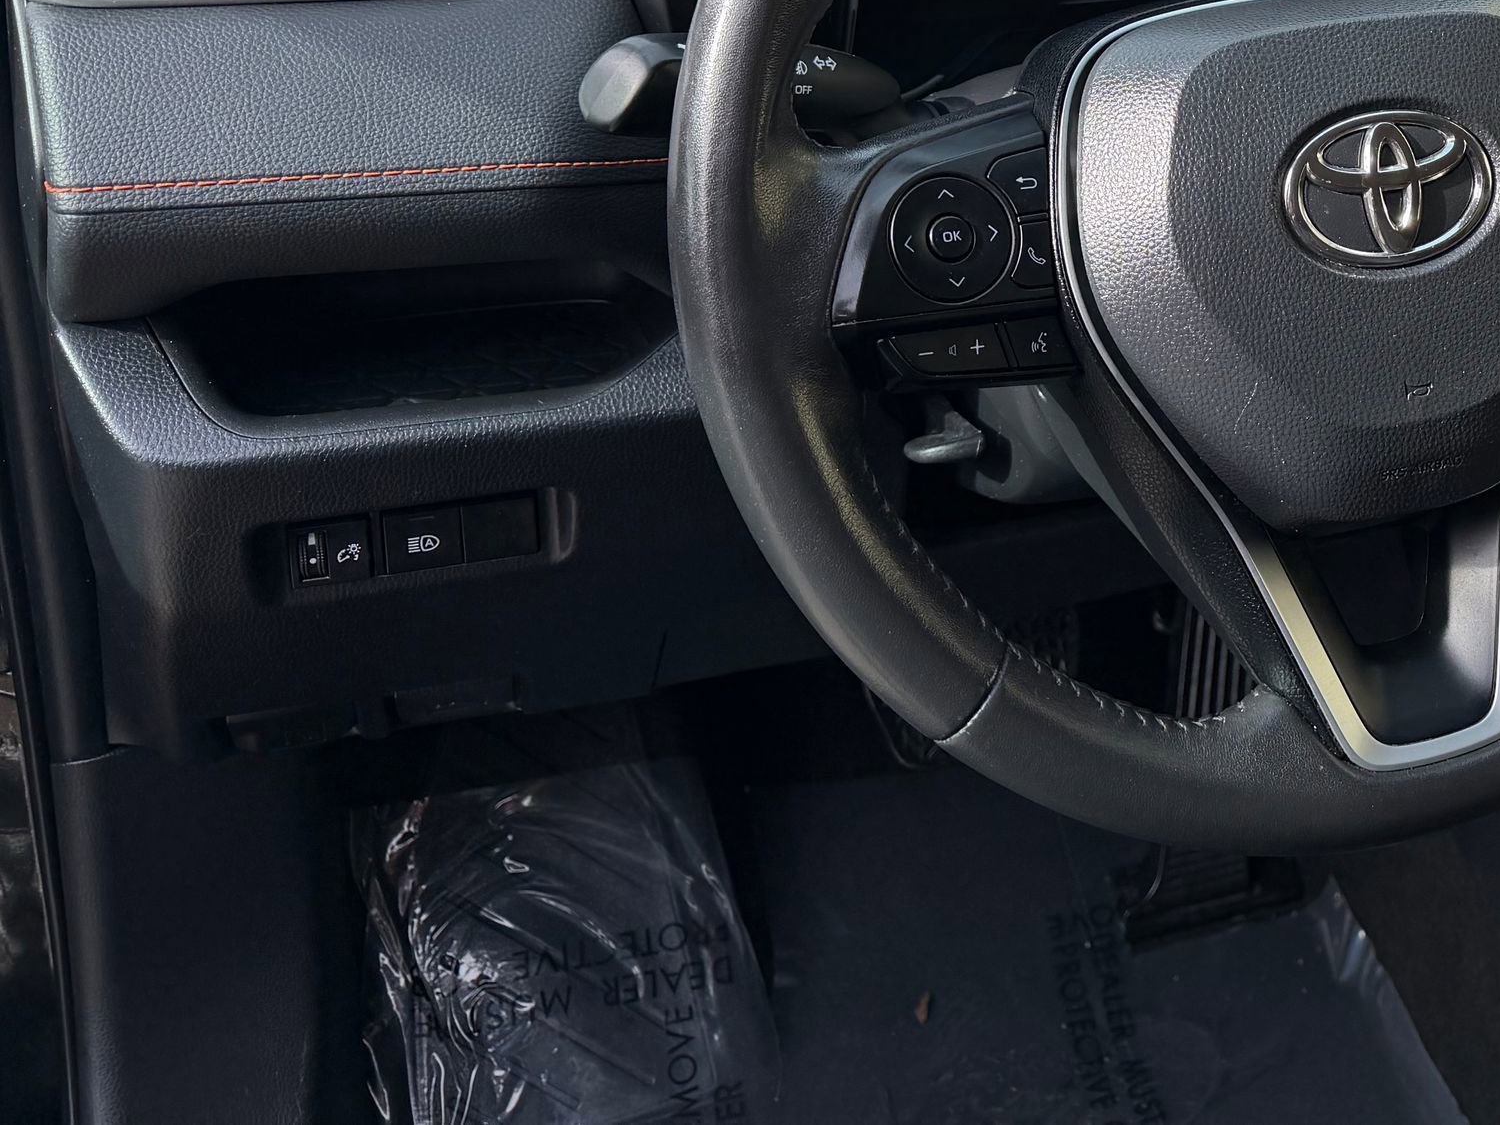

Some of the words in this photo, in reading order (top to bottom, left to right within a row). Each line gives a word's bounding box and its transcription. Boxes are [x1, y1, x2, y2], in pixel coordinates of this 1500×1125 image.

[795, 84, 813, 95] OFF
[942, 230, 963, 244] OK
[603, 956, 735, 1007] DEALER
